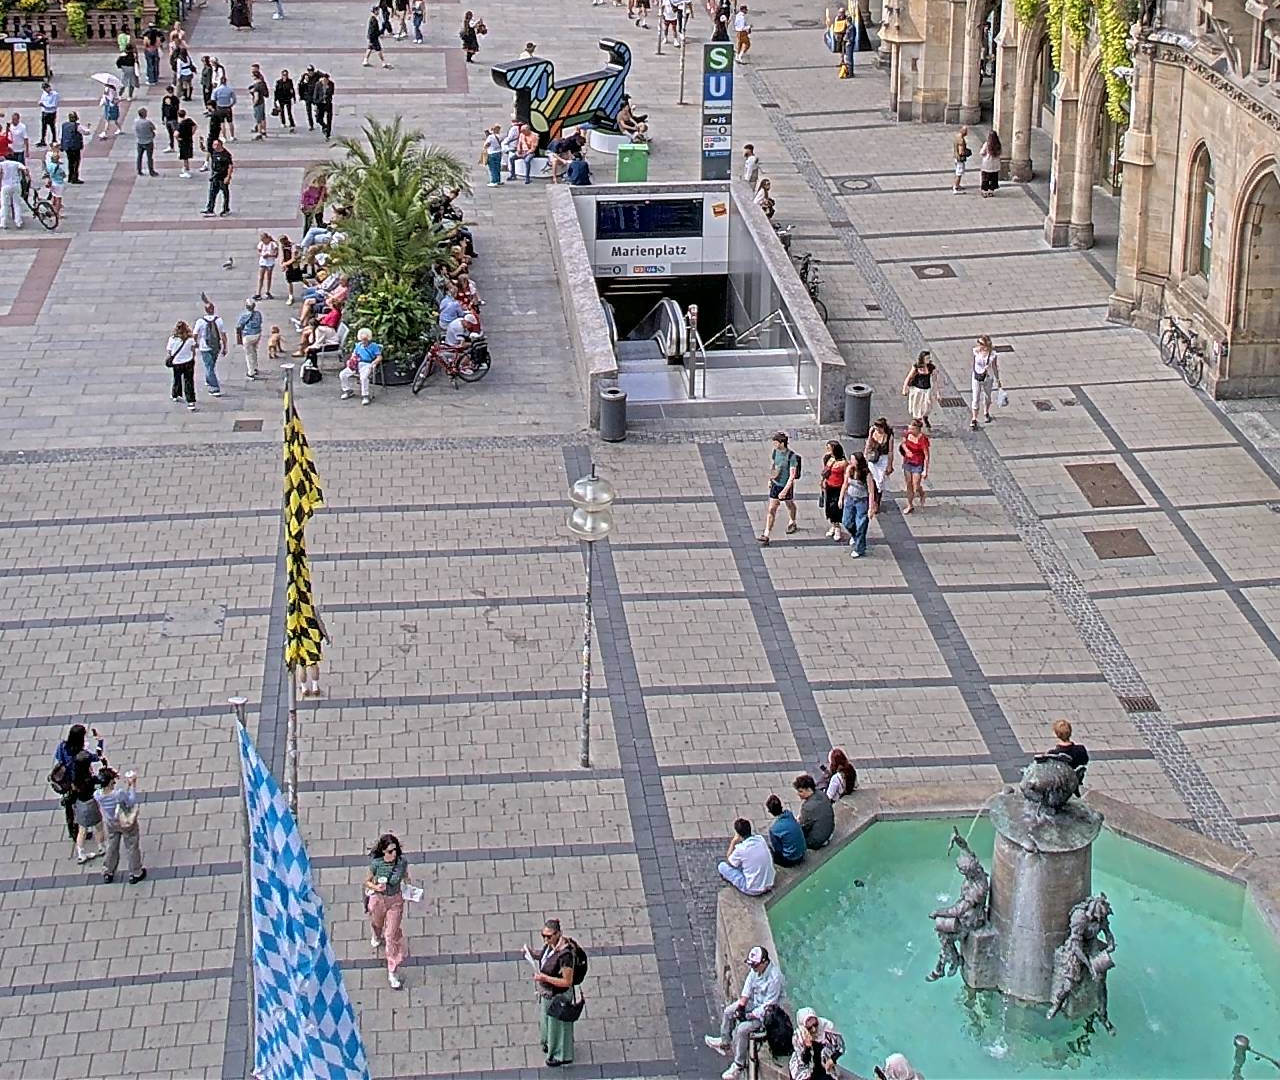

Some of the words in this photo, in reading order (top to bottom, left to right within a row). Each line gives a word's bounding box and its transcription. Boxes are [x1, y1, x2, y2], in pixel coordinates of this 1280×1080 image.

[709, 46, 729, 70] S
[709, 75, 726, 97] U
[611, 245, 687, 258] Marienplatz
